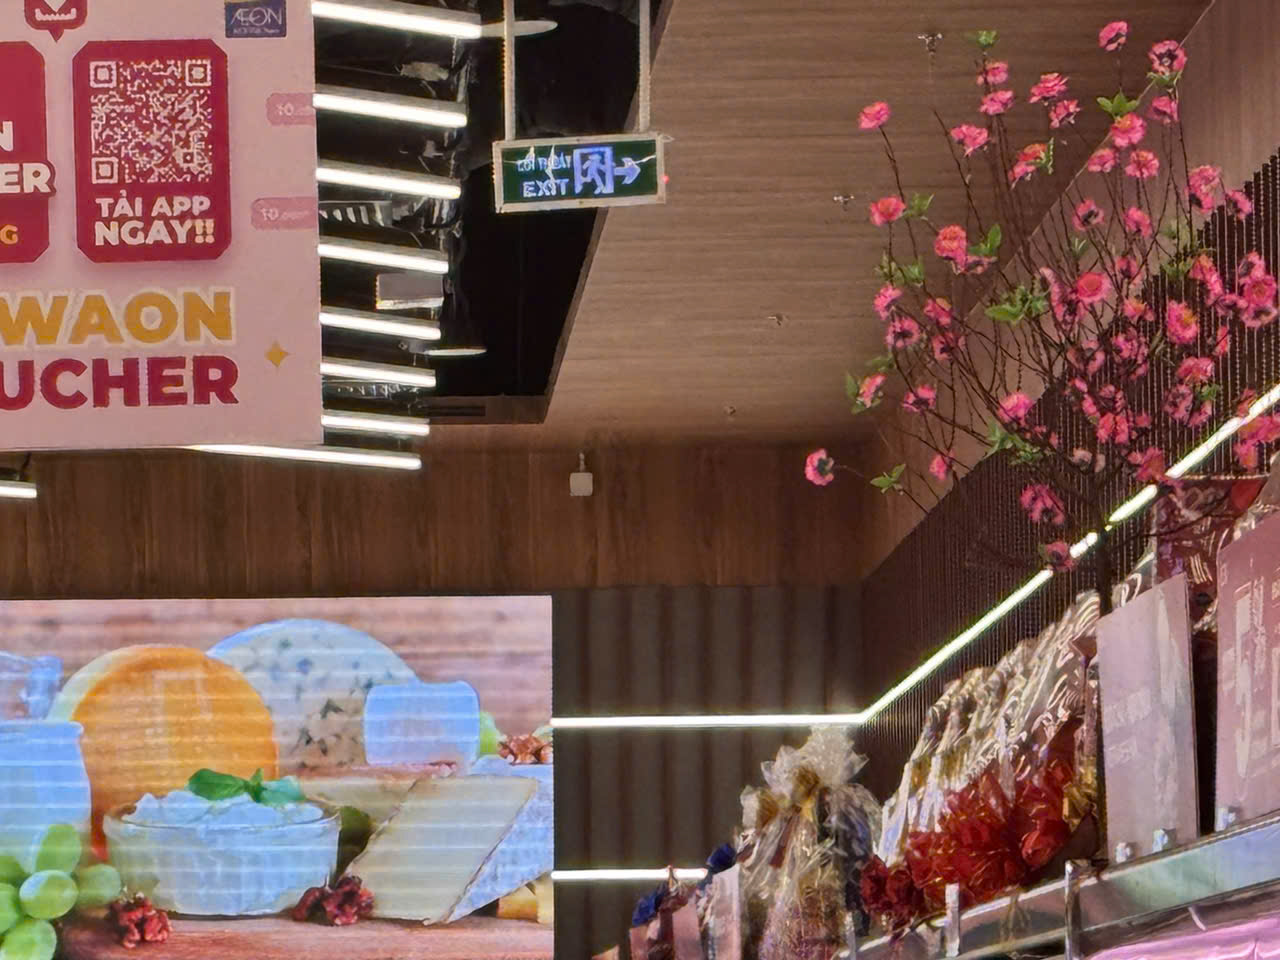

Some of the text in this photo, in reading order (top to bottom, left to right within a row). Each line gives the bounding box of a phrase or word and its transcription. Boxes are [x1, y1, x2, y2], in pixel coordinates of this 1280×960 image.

[523, 178, 570, 197] EXIT
[95, 190, 211, 218] TẢI APP
[95, 220, 215, 247] NGAY!!
